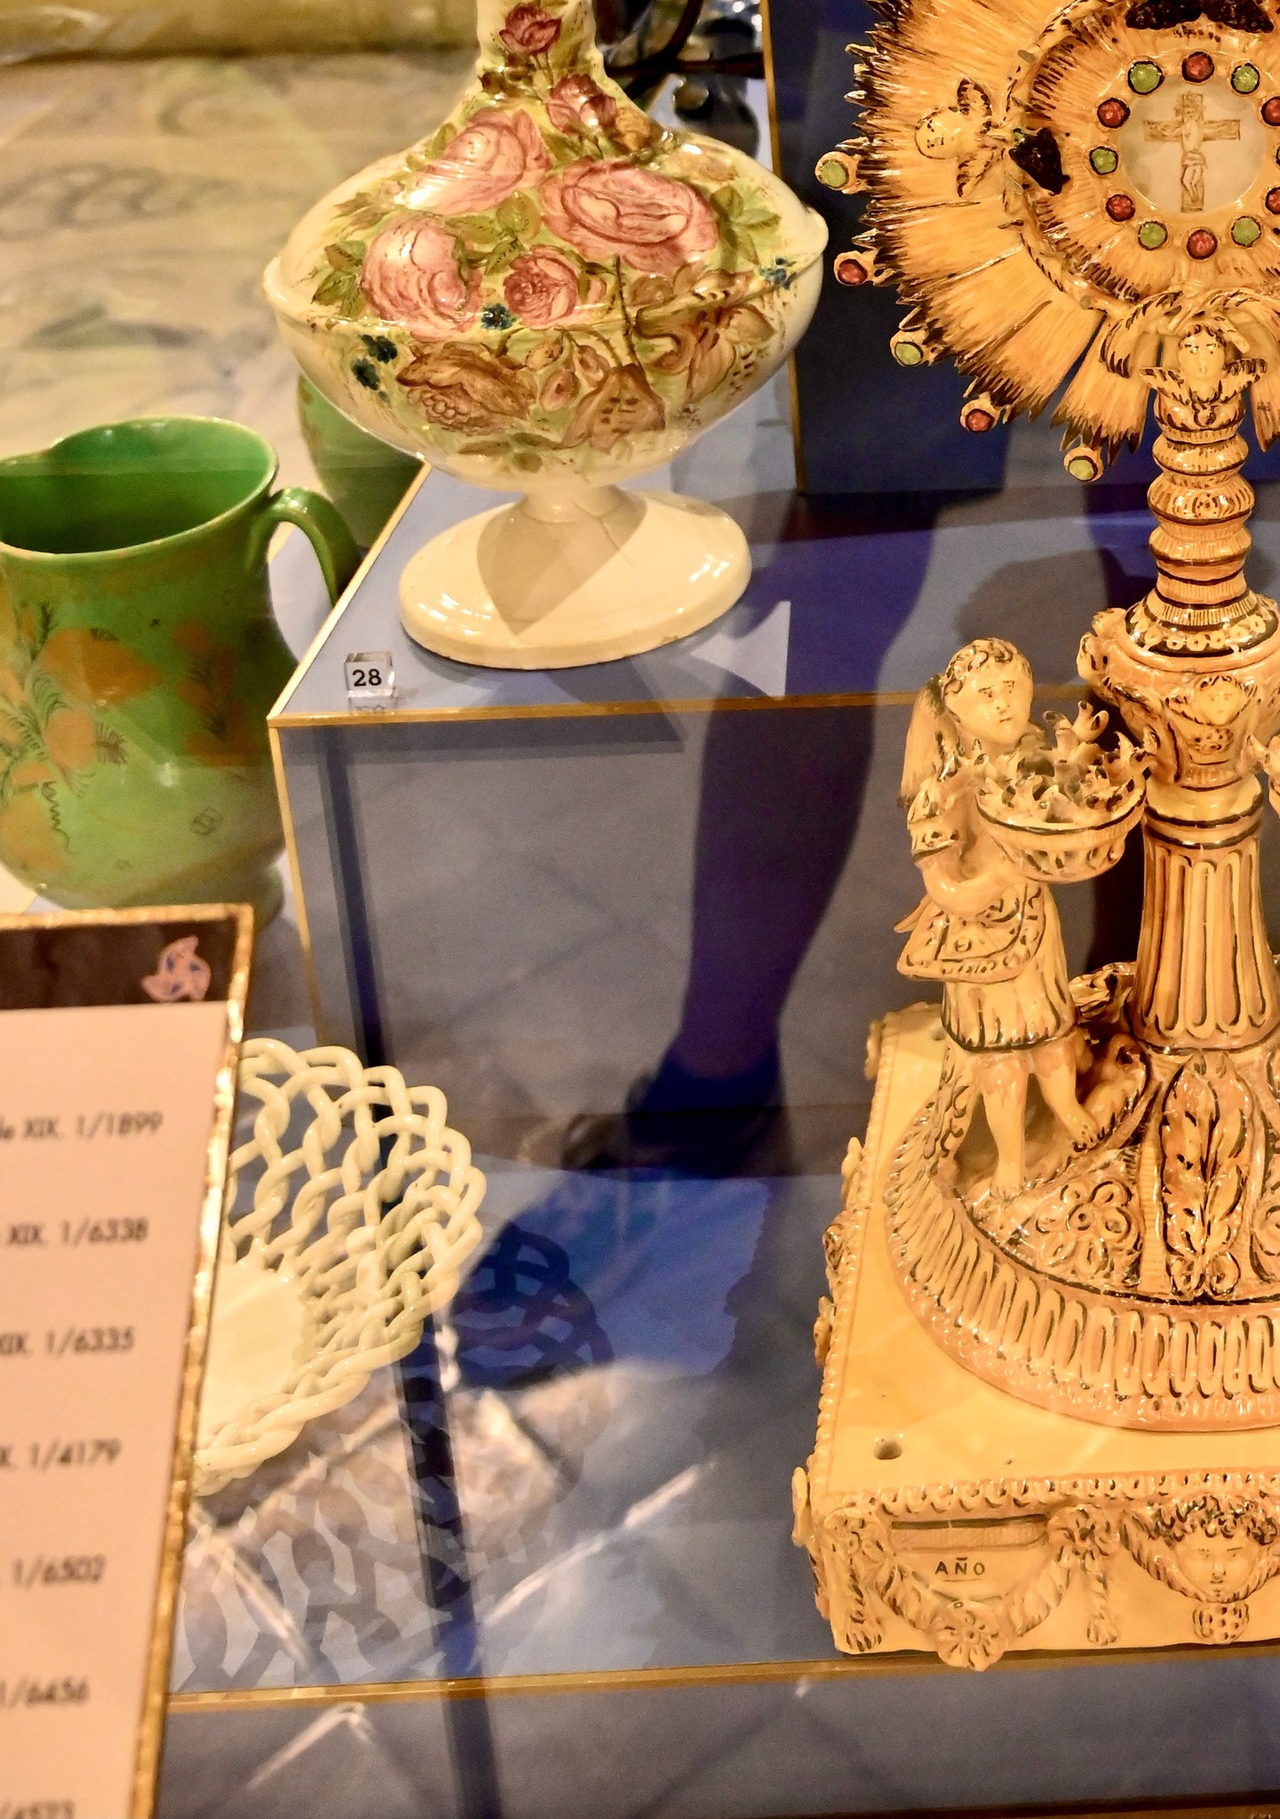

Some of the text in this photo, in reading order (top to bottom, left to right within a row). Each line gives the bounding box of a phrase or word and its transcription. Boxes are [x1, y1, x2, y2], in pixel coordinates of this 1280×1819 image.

[352, 668, 383, 688] 28
[76, 1110, 164, 1141] 1/1899
[62, 1215, 150, 1248] 1/6338
[46, 1325, 135, 1358] 1/6335
[30, 1436, 122, 1472] 1/4179
[12, 1553, 105, 1589] 1/6502
[935, 1557, 985, 1576] AÑO
